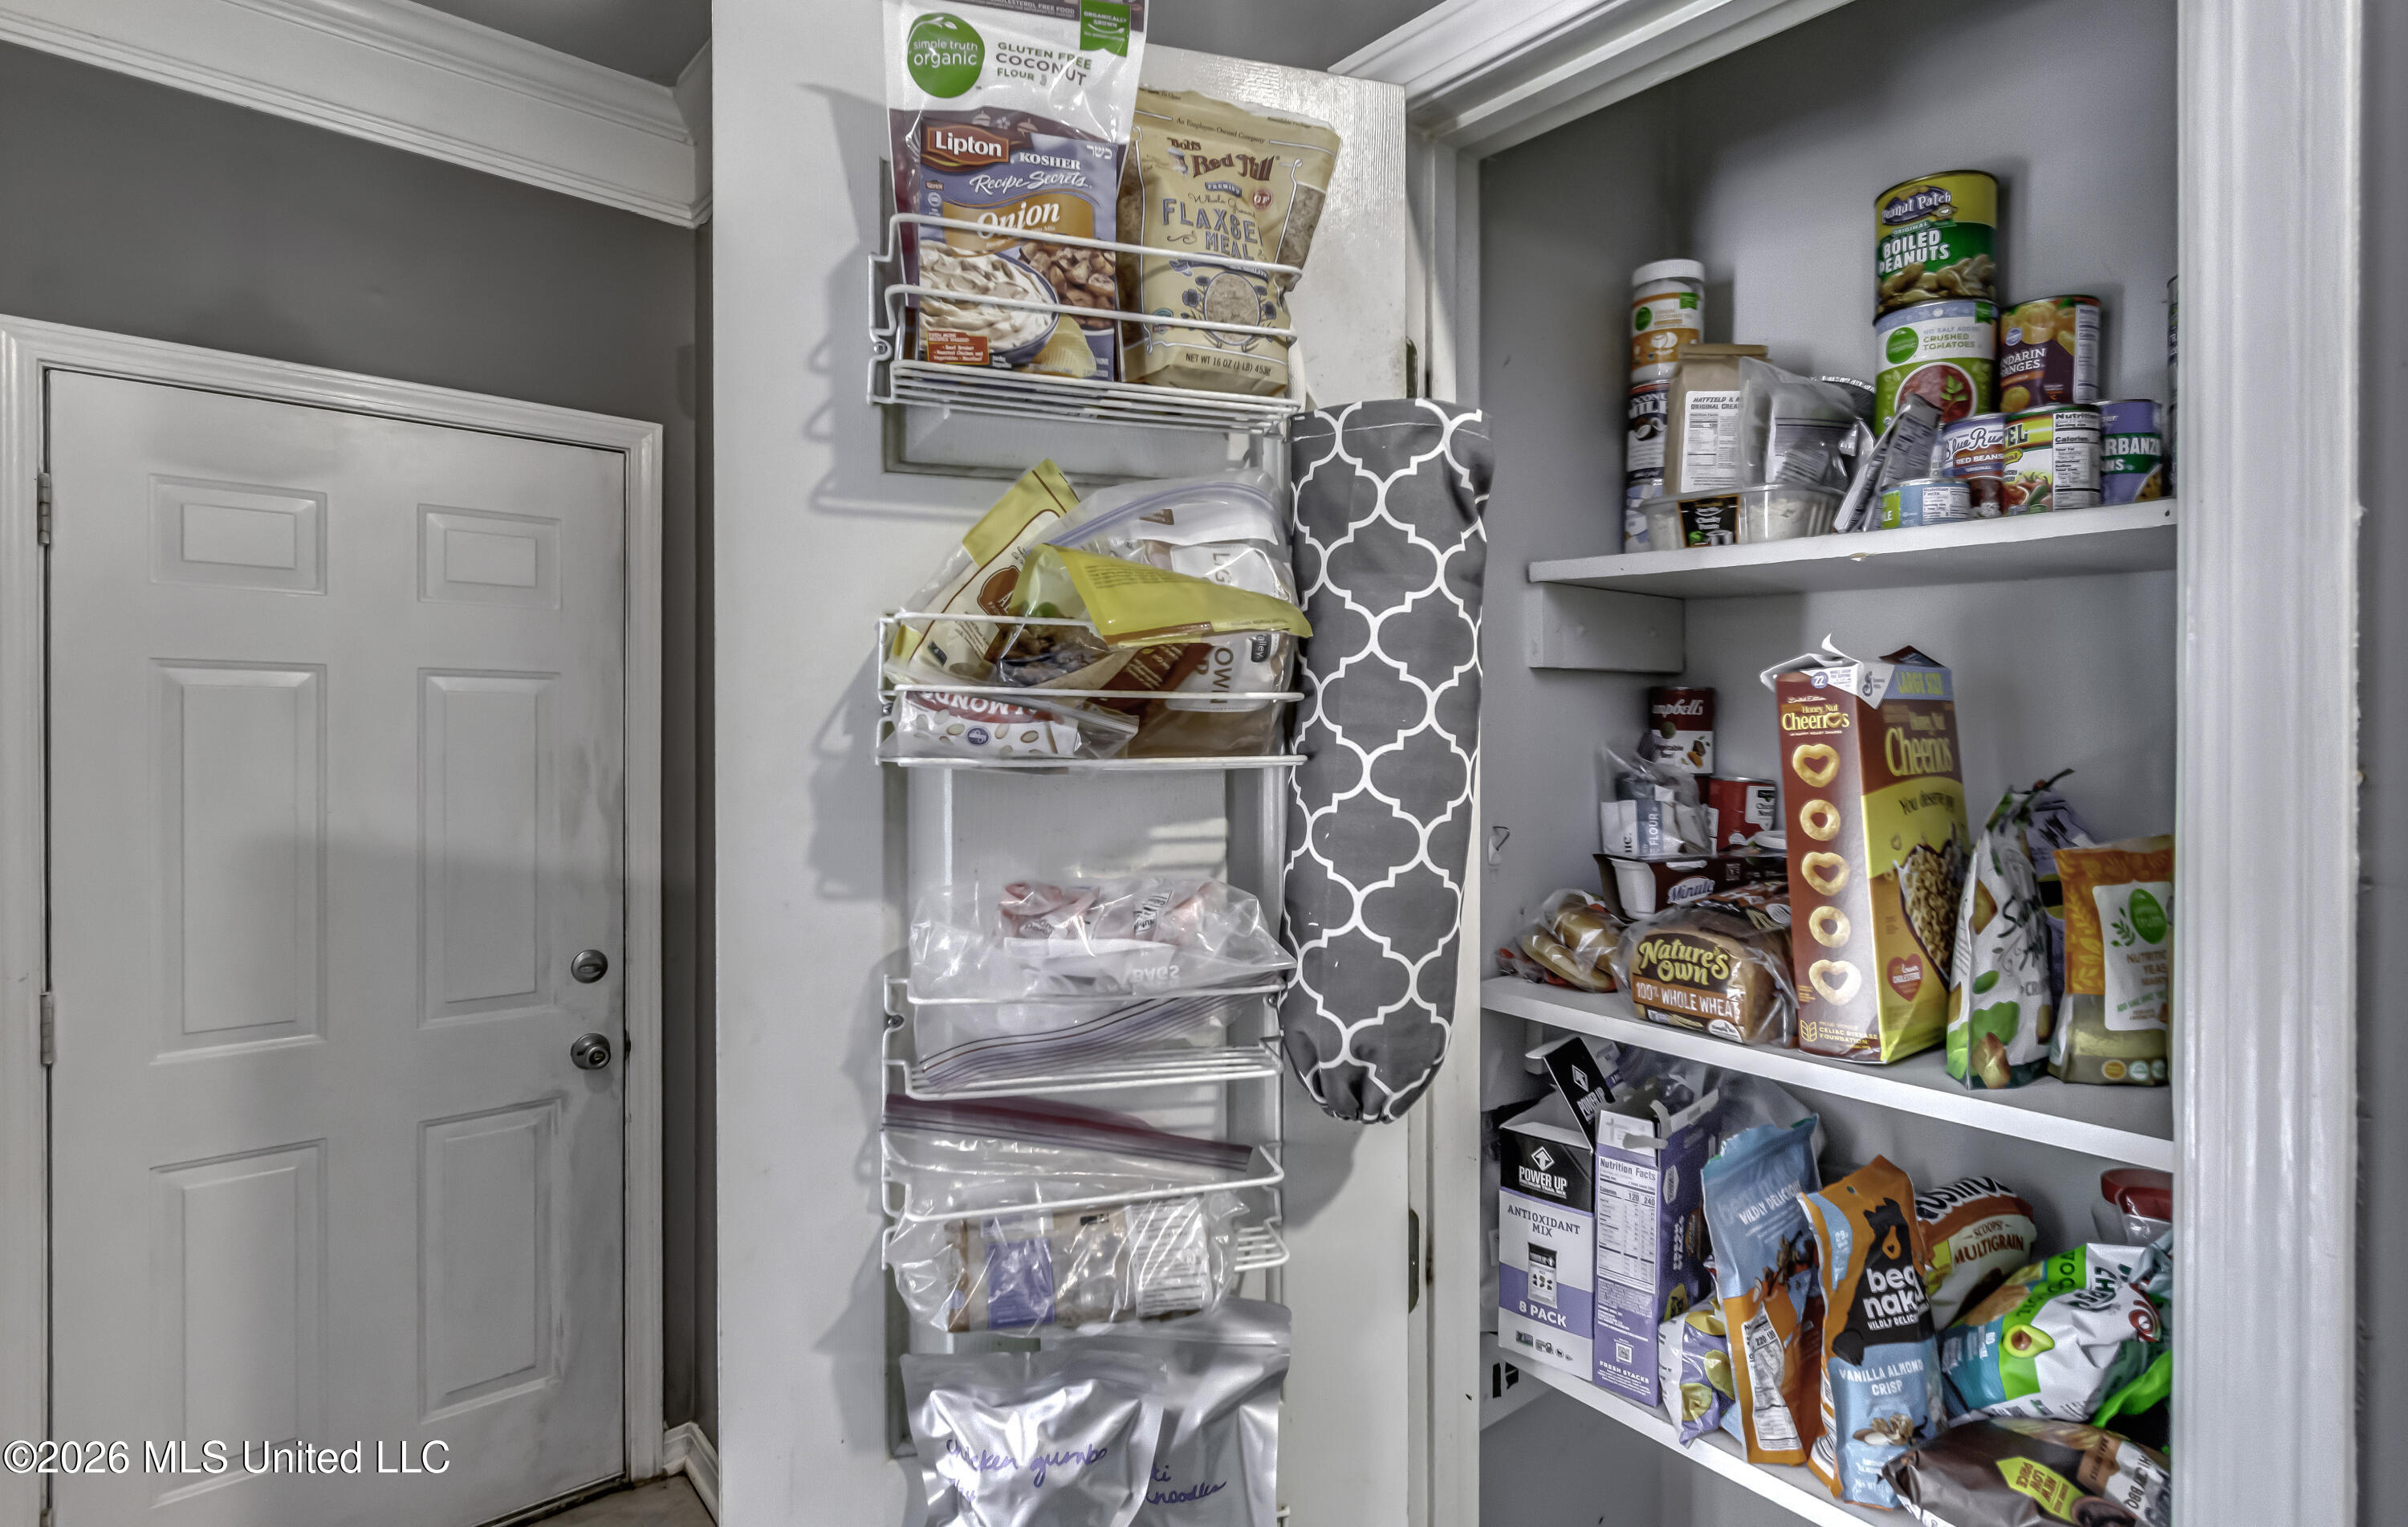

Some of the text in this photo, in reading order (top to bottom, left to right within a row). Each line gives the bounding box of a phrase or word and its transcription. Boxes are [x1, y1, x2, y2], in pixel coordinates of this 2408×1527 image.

[1084, 11, 1127, 22] ORGANICALLY
[1093, 19, 1118, 27] GROWN
[913, 39, 978, 51] simple truth
[998, 42, 1092, 71] GLUTEN FREE
[913, 51, 977, 68] organic
[995, 53, 1087, 86] COCONUT
[997, 67, 1035, 82] FLOUR
[935, 130, 1002, 157] Lipton
[1087, 144, 1112, 160] כשר
[1019, 152, 1081, 171] KOSHER
[1191, 153, 1275, 181] Red Mill
[969, 174, 1029, 196] Recipe
[1882, 190, 1951, 223] Peanut Patch
[977, 201, 1060, 239] Onion
[1162, 197, 1264, 247] FLAXSE
[1893, 222, 1928, 235] ORIGINAL
[1205, 230, 1255, 261] MEAL
[1884, 230, 1941, 259] BOILED
[1879, 244, 1950, 273] PEANUTS
[1923, 333, 1969, 343] CRUSHED
[1923, 341, 1975, 350] TOMATOES
[1186, 352, 1198, 362] NET
[1201, 356, 1210, 364] WT
[1213, 357, 1221, 366] 16
[1223, 359, 1232, 368] OZ
[1242, 362, 1253, 373] LB)
[1255, 364, 1271, 376] 453g
[2002, 348, 2046, 365] NDARIN
[1946, 439, 1971, 461] Blue
[1974, 453, 2003, 462] BEANS
[2105, 438, 2159, 455] RBANZ
[1256, 634, 1266, 658] alley
[1210, 647, 1234, 704] OWN
[1814, 675, 1824, 685] 22
[1897, 671, 1943, 695] LARGE SIZE
[1802, 704, 1838, 714] Honey Nut
[1886, 727, 1954, 776] Cheerios
[1649, 813, 1658, 845] FLOUR
[1670, 881, 1714, 902] Minute
[1639, 939, 1730, 979] Nature's
[2143, 965, 2166, 974] YEAS
[1658, 960, 1710, 985] Own
[1636, 983, 1658, 1000] 100%
[1661, 988, 1697, 1012] WHOLE
[1819, 1027, 1878, 1040] CELIAC DISEASE
[1820, 1033, 1869, 1044] FOUNDATION
[1577, 1089, 1599, 1117] POWER
[1519, 1166, 1568, 1191] POWER UP
[1600, 1158, 1656, 1180] Nutrition Facts
[1629, 1192, 1639, 1201] 120
[1644, 1197, 1655, 1205] 240
[1507, 1205, 1580, 1235] ANTIOXIDANT
[1739, 1202, 1767, 1225] WILDLY
[1532, 1224, 1552, 1237] MIX
[1954, 1233, 2024, 1265] MULTIGRAIN
[1519, 1301, 1567, 1328] 8 PACK
[1868, 1313, 1918, 1331] WILDLY DELICI
[1755, 1335, 1766, 1346] 220
[1599, 1361, 1621, 1373] FRESH
[1622, 1367, 1649, 1384] STACKS
[1838, 1359, 1923, 1382] VANILLA ALMOND
[1872, 1380, 1903, 1396] CRISP
[1030, 1444, 1108, 1488] gumbo
[2016, 1462, 2034, 1488] PRICE
[2030, 1469, 2045, 1492] LOW
[2040, 1476, 2057, 1503] NEW
[2125, 1484, 2145, 1509] BBQ
